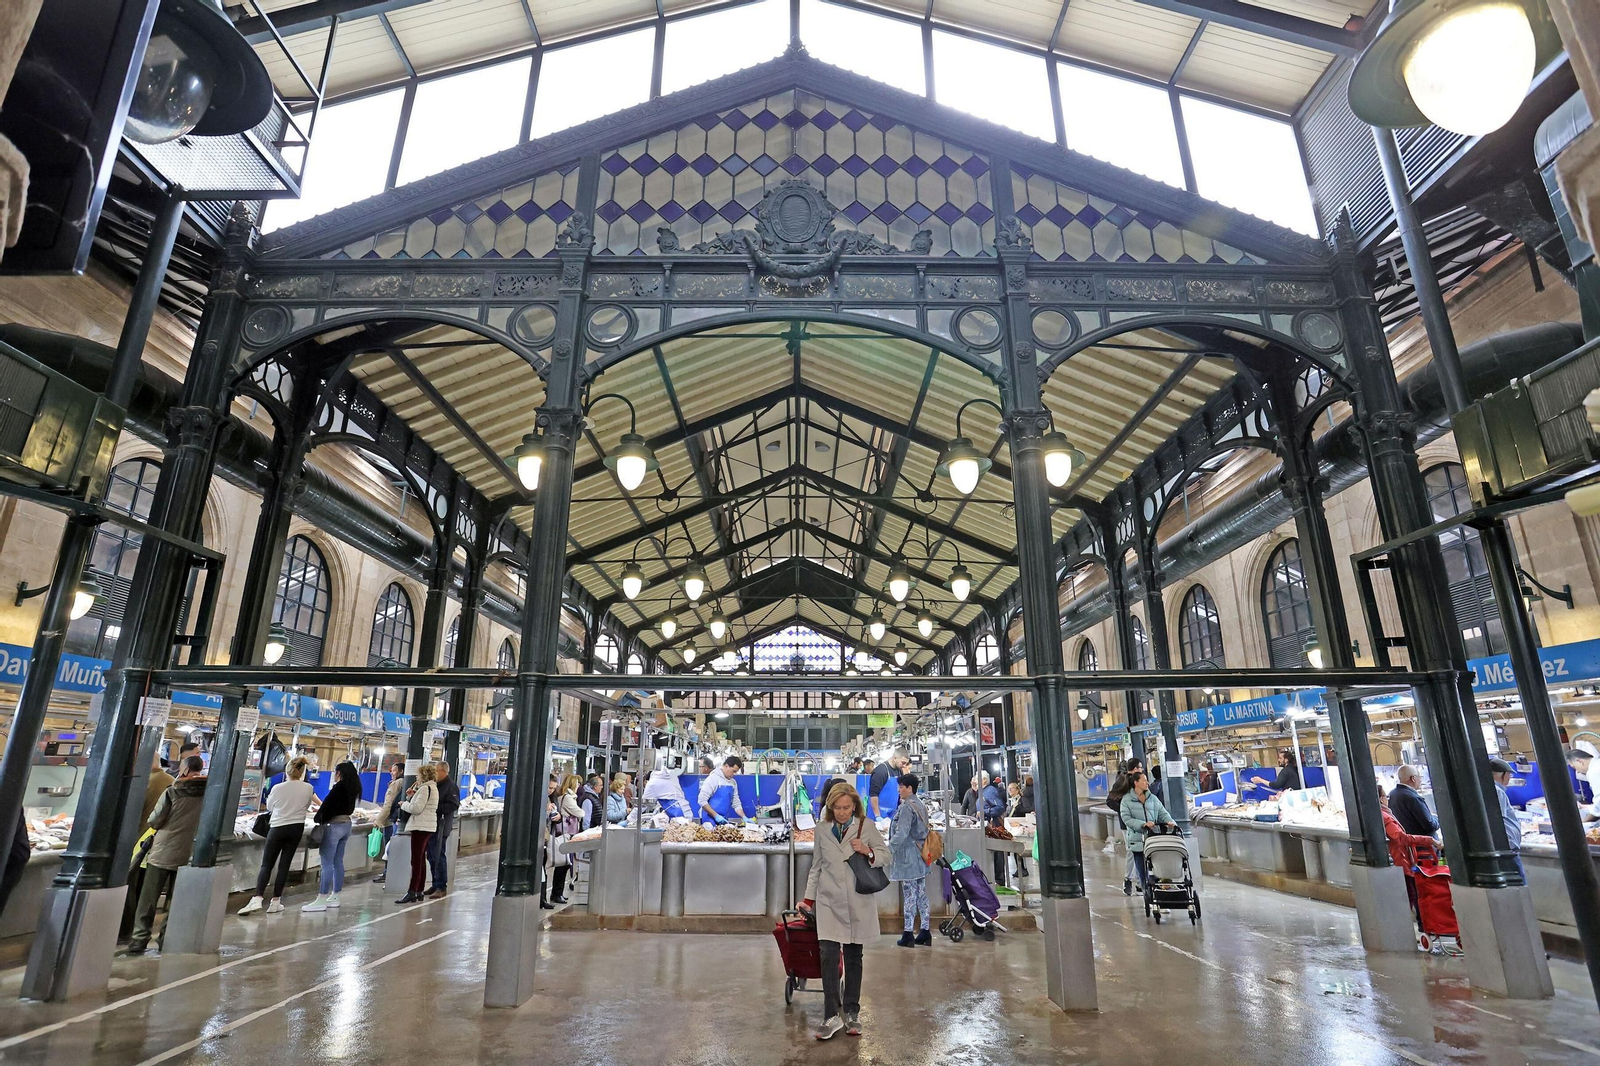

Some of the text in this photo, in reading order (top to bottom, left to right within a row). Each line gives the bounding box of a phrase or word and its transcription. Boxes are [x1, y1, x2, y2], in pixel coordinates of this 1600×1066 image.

[0, 649, 30, 677] Dav
[1472, 659, 1569, 687] J.Méez
[280, 693, 298, 717] 15
[318, 702, 357, 724] M.Segura
[1223, 700, 1275, 721] LA MARTINA
[370, 709, 384, 729] 16
[1177, 712, 1199, 727] ARSUR
[1207, 708, 1215, 726] 5
[767, 750, 790, 758] Muñz
